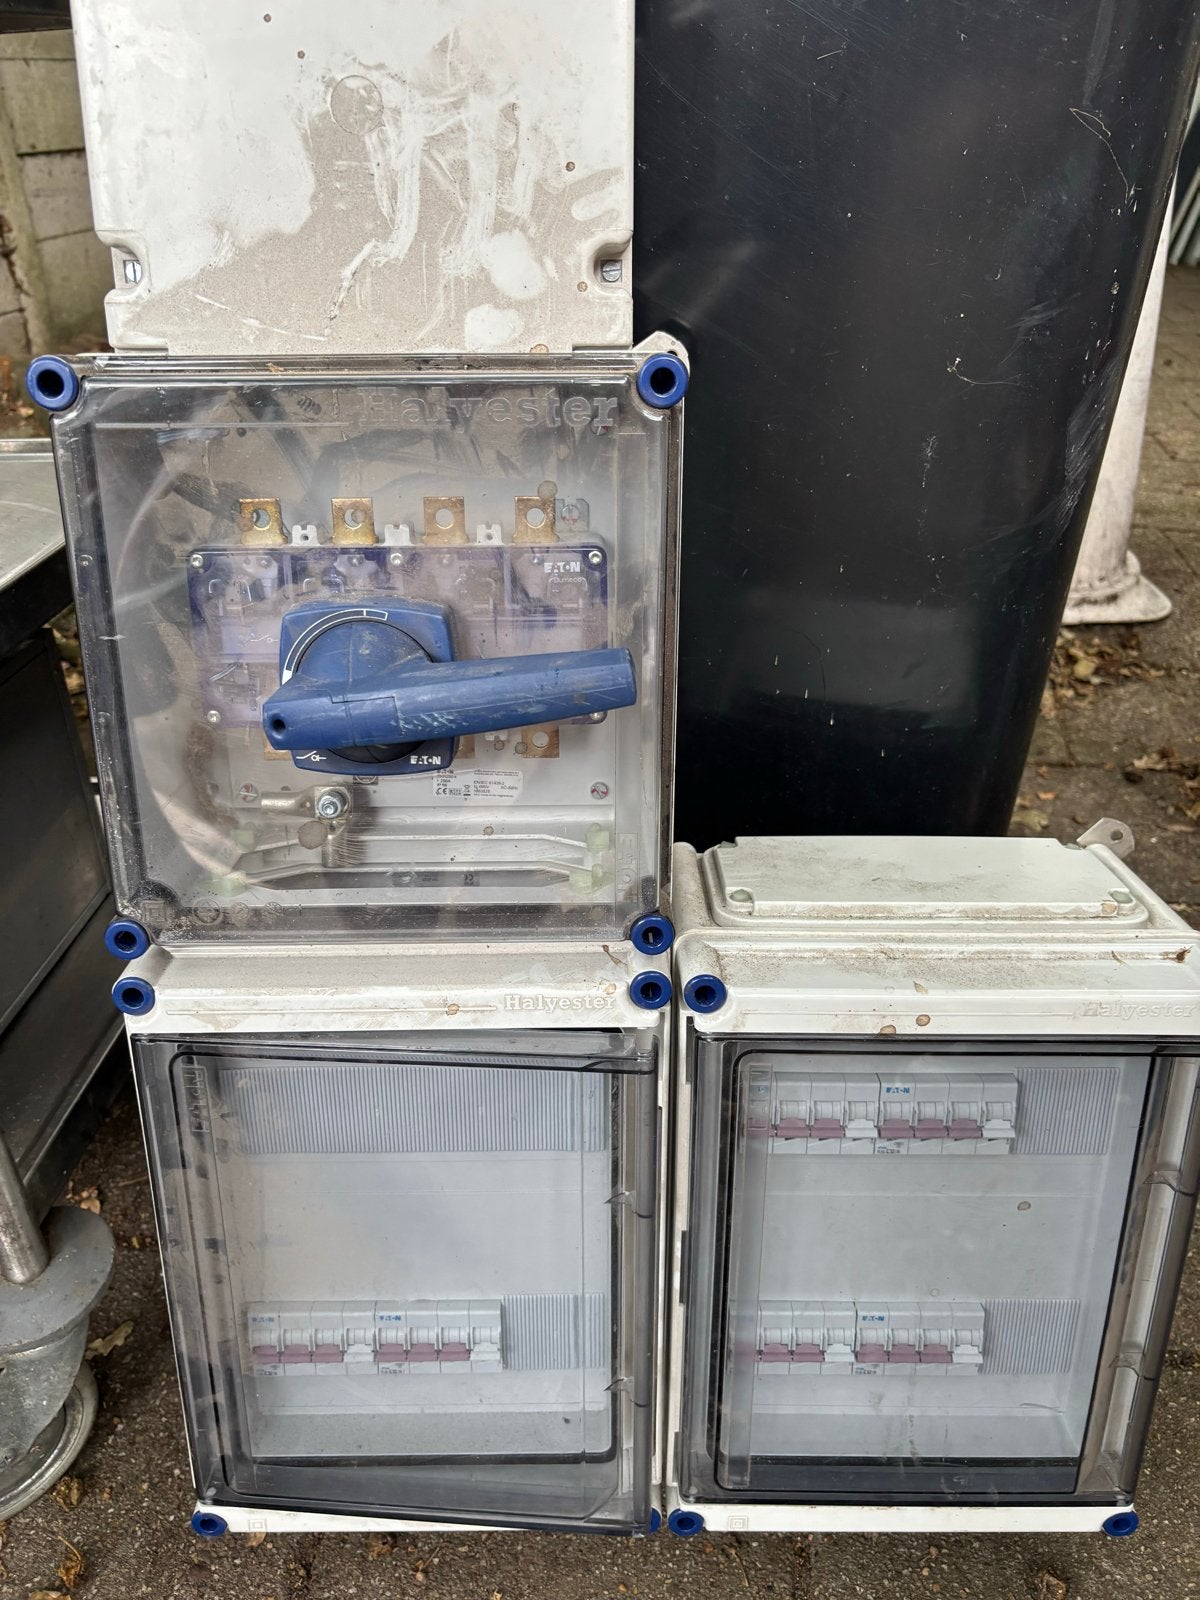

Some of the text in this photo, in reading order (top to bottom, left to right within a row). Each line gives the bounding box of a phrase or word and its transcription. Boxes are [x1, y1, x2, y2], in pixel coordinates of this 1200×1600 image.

[544, 561, 581, 573] EATON
[410, 755, 441, 765] EATON
[504, 994, 616, 1013] Halyester
